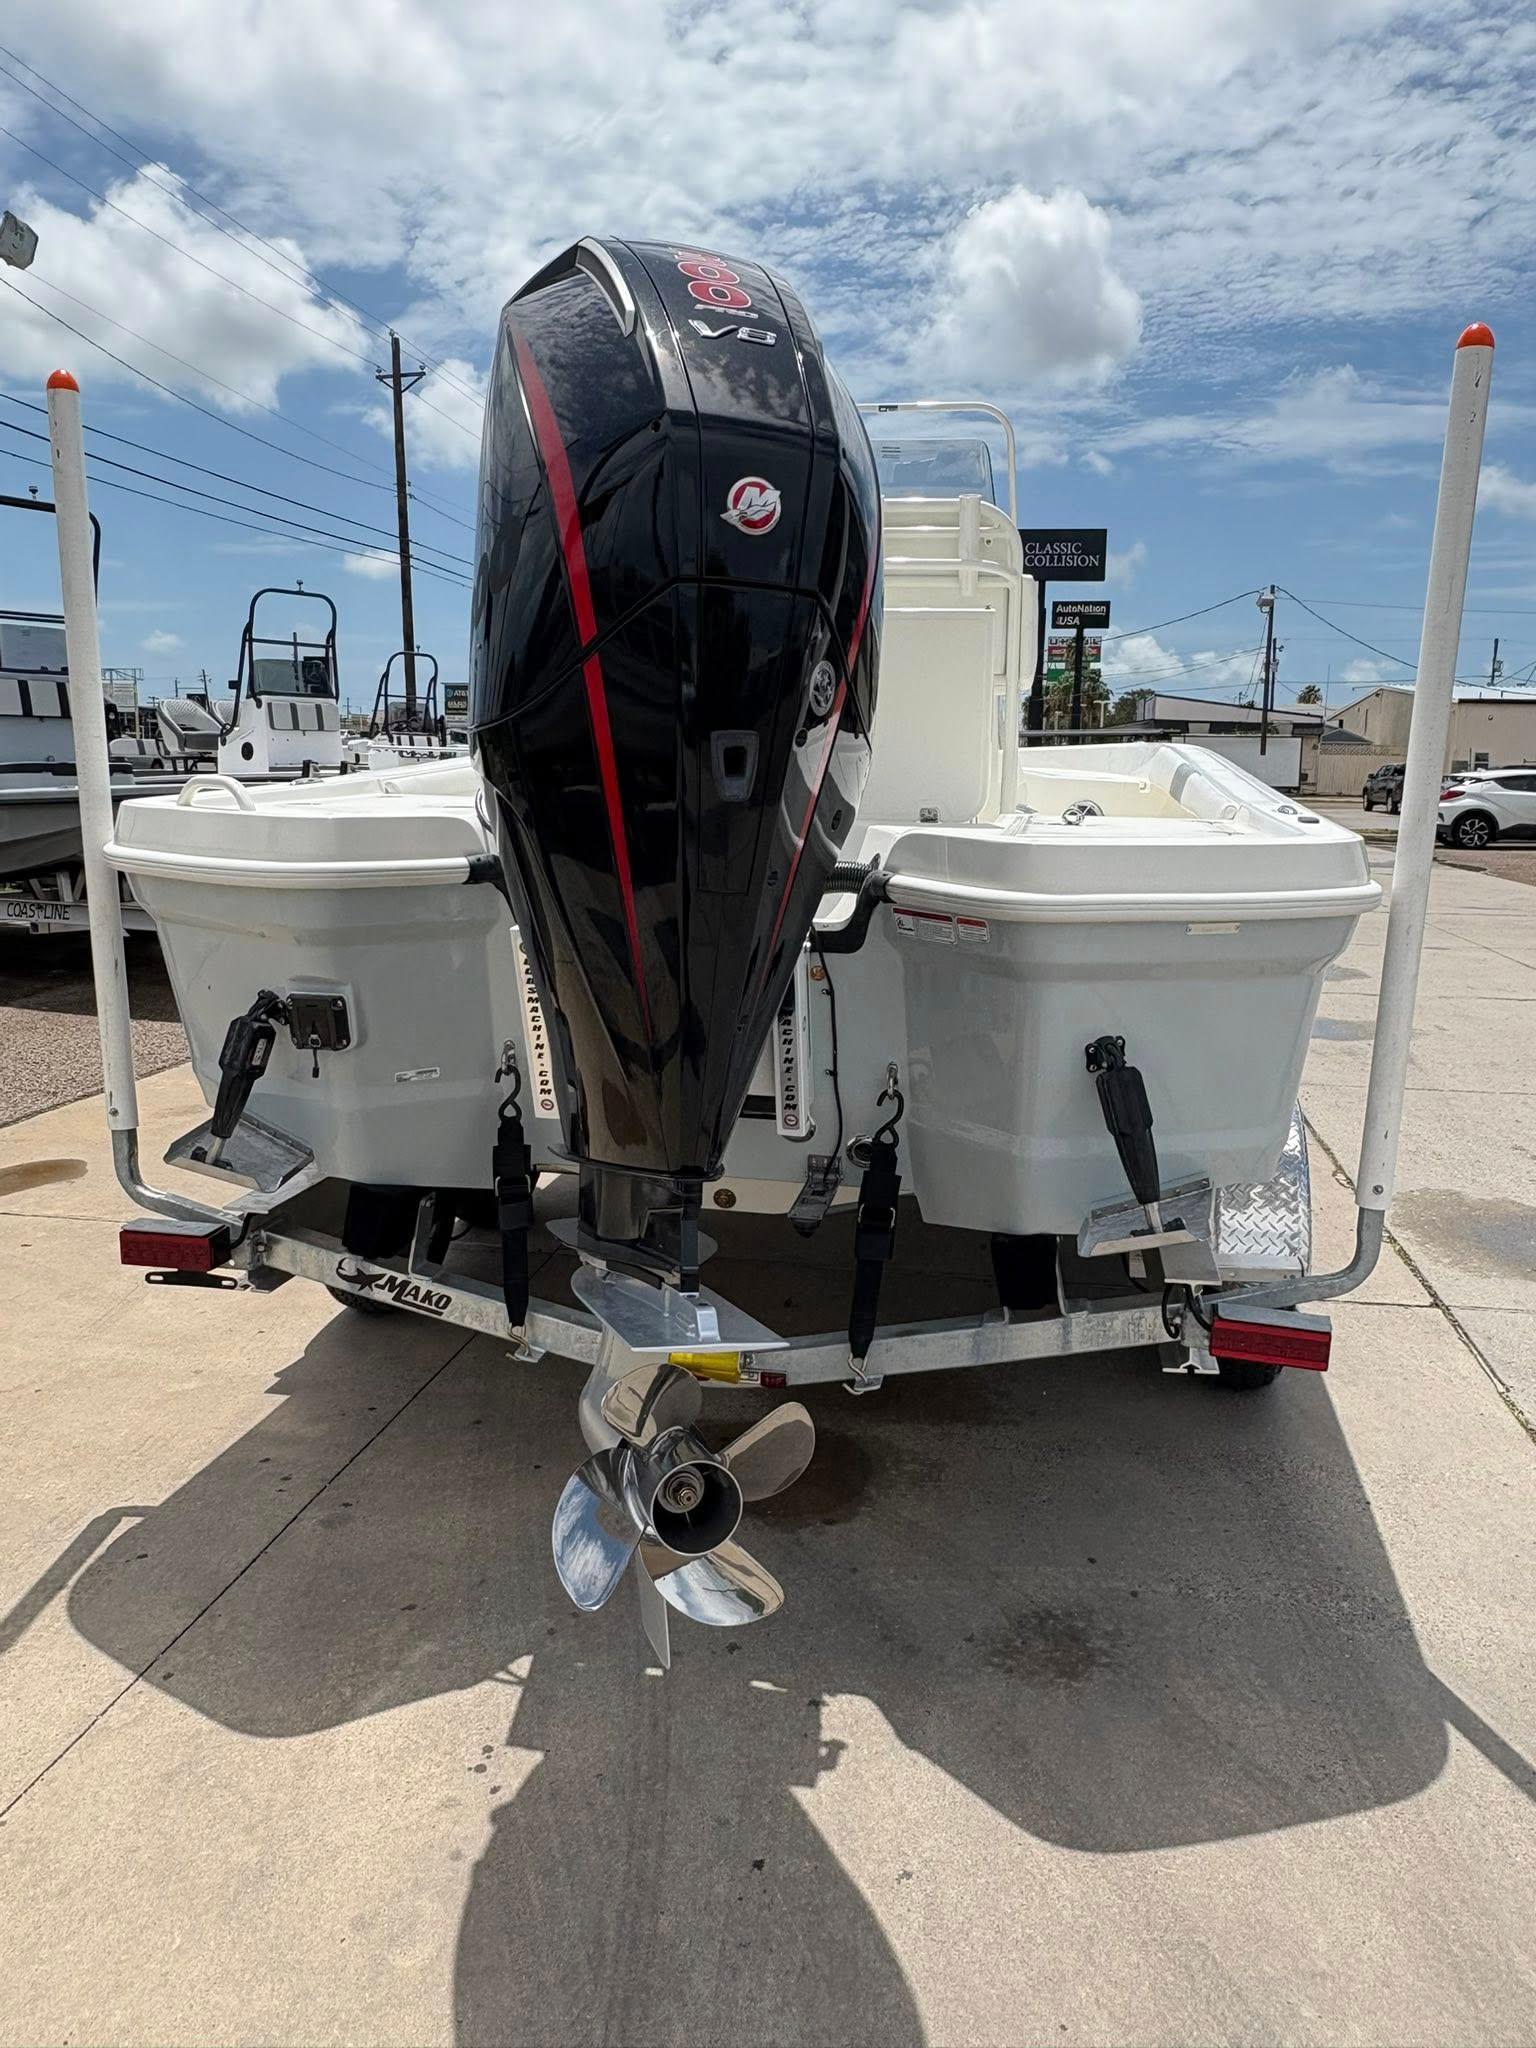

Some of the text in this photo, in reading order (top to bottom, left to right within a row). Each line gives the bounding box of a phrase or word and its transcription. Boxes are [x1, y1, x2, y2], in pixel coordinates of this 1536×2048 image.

[687, 318, 777, 346] V8
[1024, 542, 1082, 554] CLASSIC
[1024, 554, 1100, 567] COLLISION
[1056, 604, 1107, 615] AutoNation
[1058, 616, 1081, 626] USA
[373, 1274, 453, 1317] MAKO
